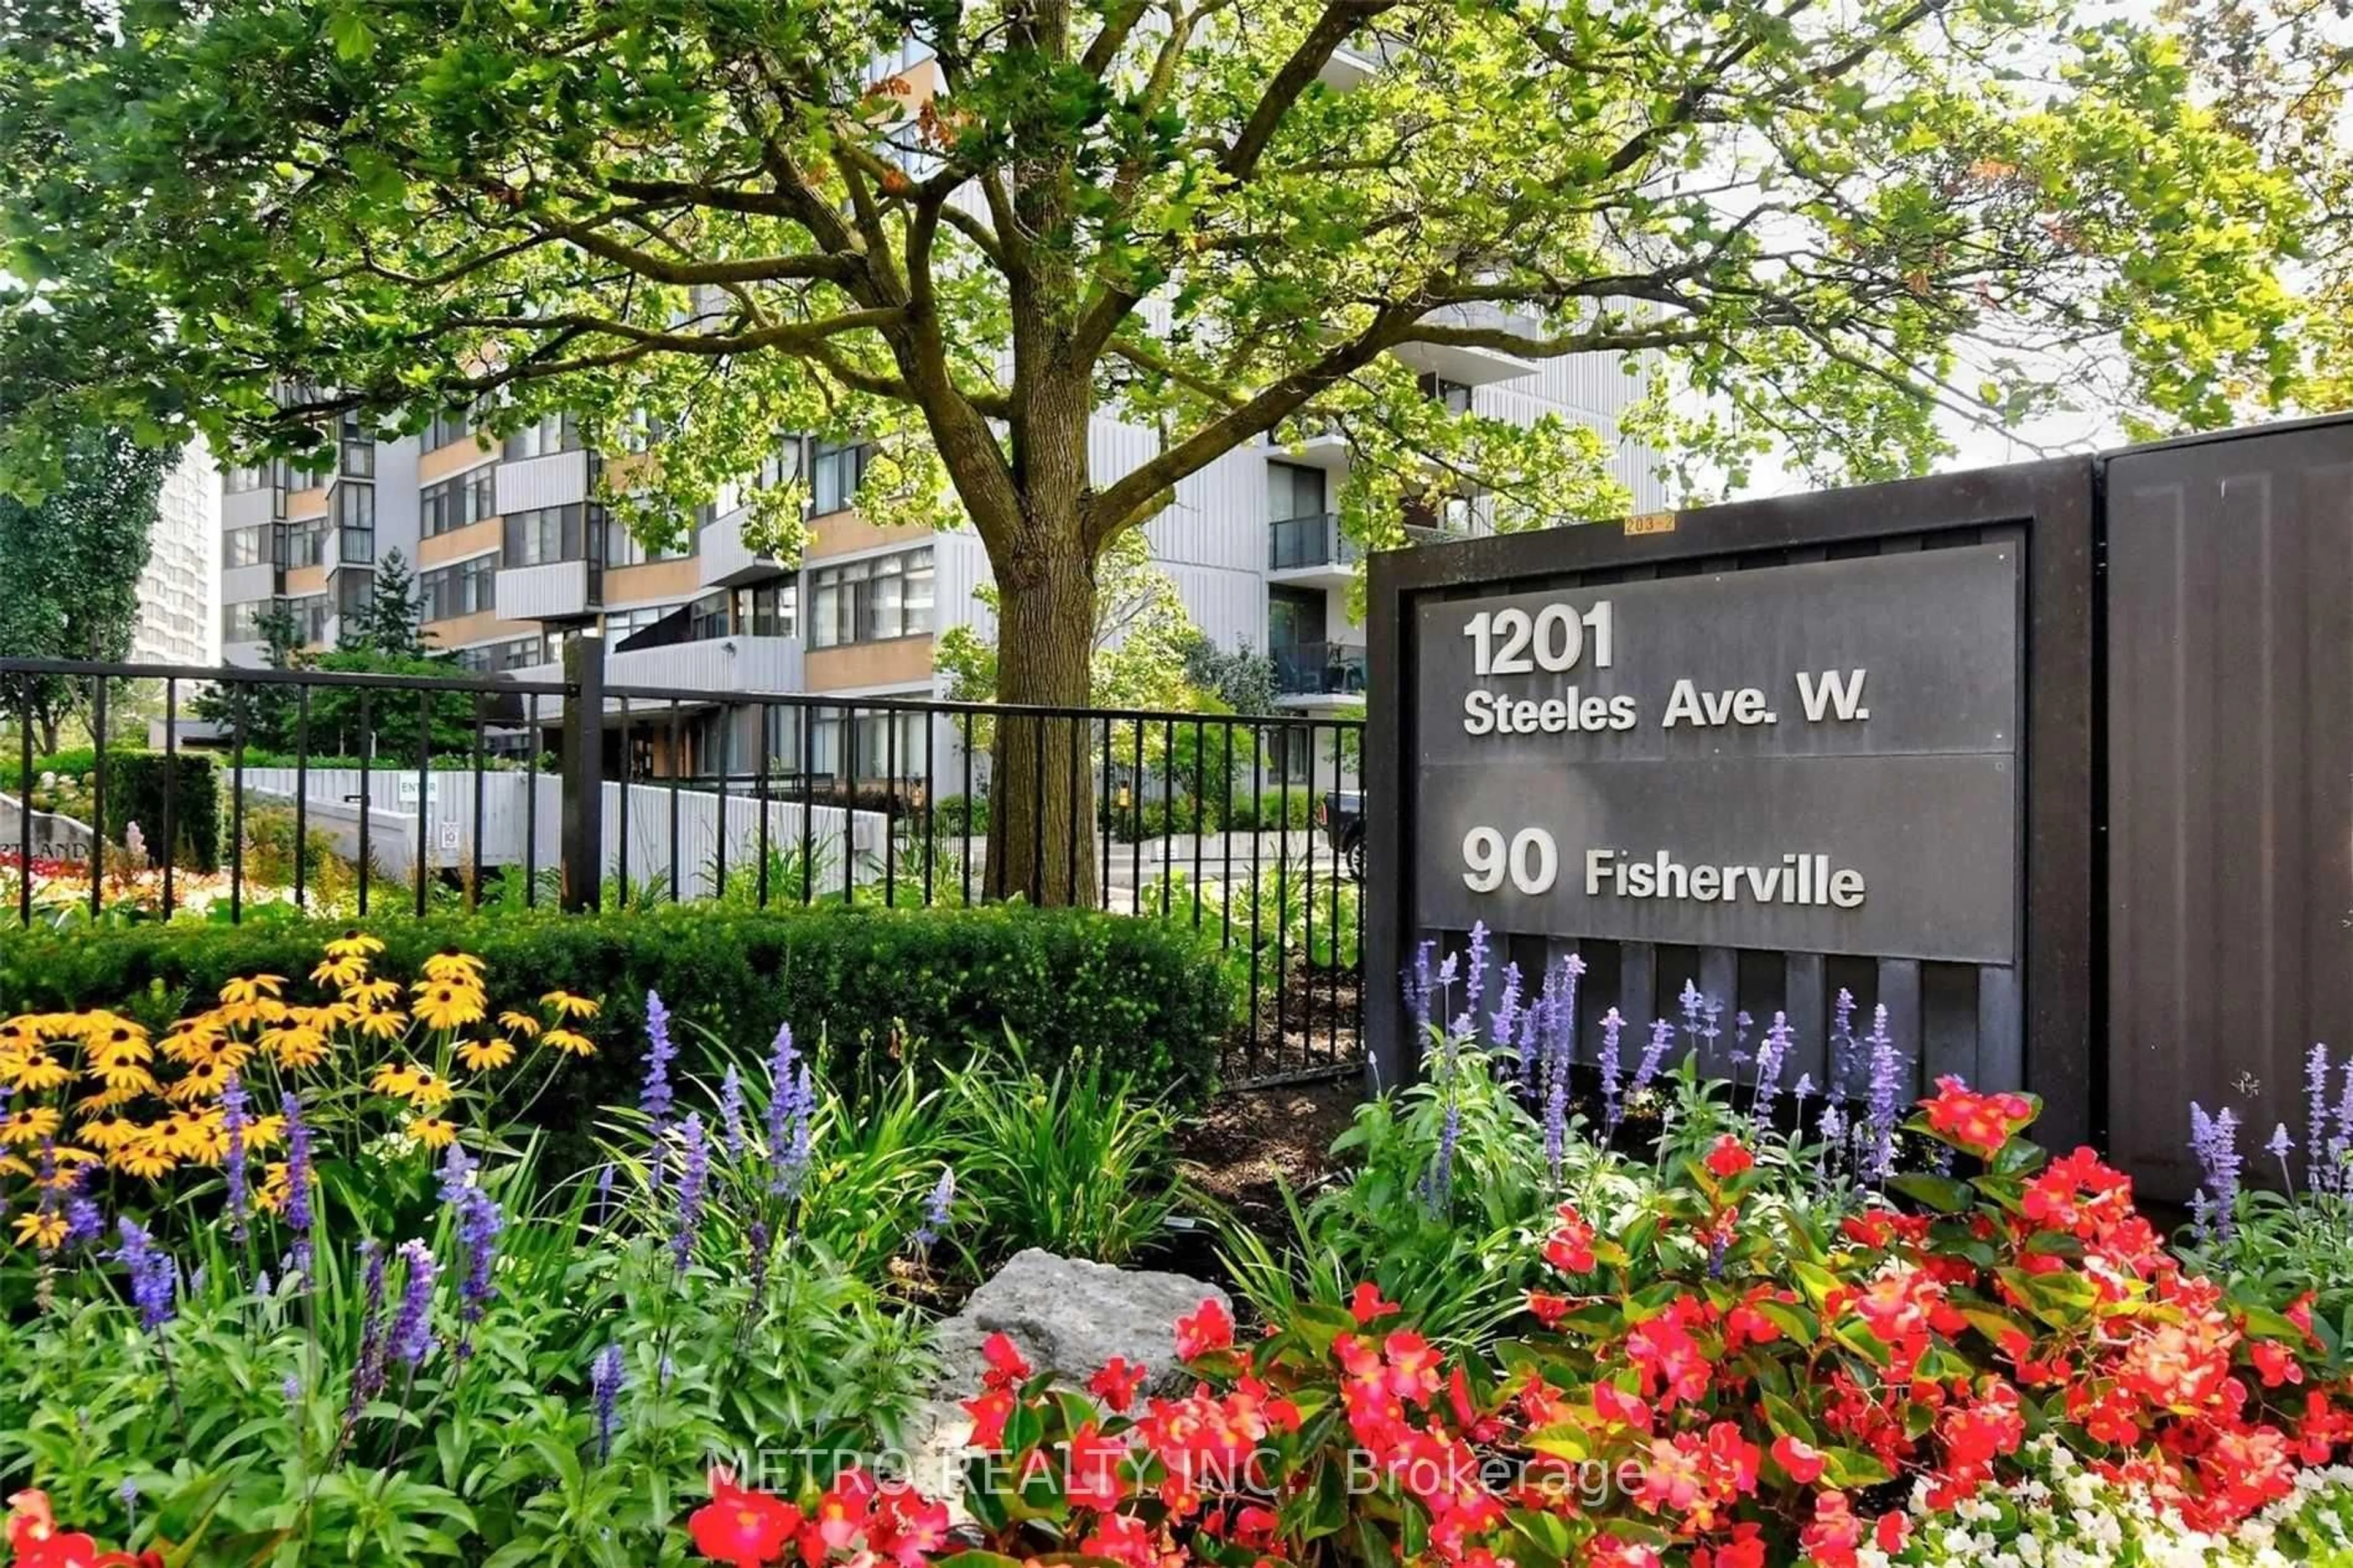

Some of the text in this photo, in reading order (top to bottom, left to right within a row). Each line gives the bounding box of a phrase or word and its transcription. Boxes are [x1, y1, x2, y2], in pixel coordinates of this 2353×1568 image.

[1464, 600, 1612, 675] 1201
[1463, 668, 1870, 735] Steeles Ave. W.
[401, 782, 436, 793] ENR
[1463, 826, 1866, 908] 90 Fisherville
